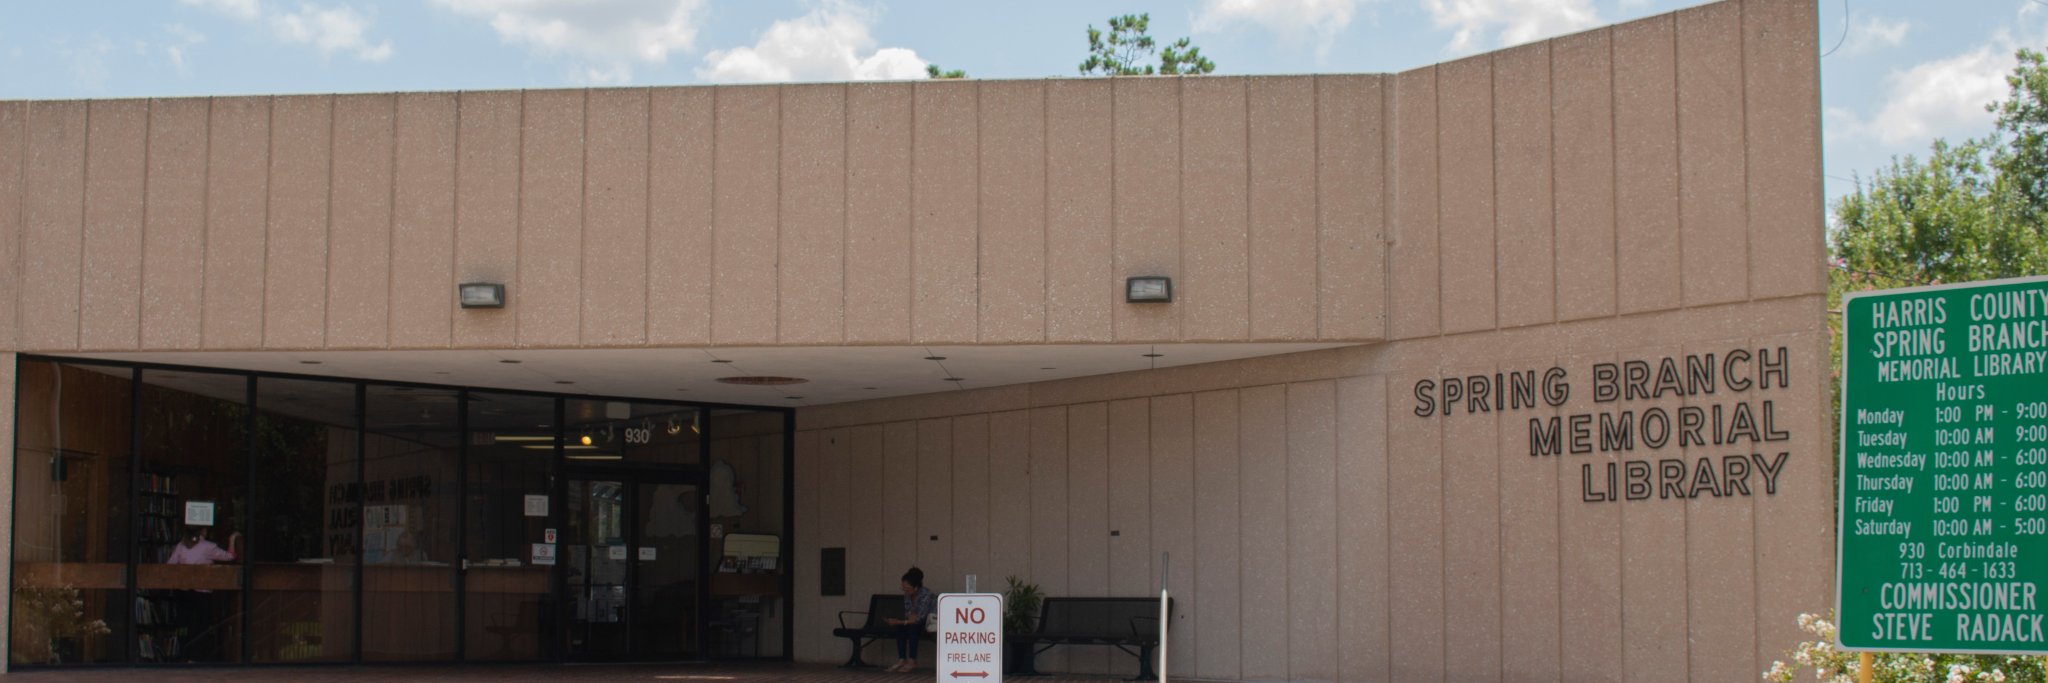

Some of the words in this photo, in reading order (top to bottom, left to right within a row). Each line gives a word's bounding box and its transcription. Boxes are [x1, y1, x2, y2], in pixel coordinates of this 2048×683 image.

[1873, 298, 1947, 329] HARRIS
[1970, 289, 2048, 321] COUNTY
[1873, 328, 1945, 358] SPRING
[1878, 357, 1961, 382] MEMORIAL
[1974, 350, 2047, 377] LIBRARY
[1414, 367, 1570, 418] SPRING
[1592, 347, 1789, 403] BRANCH
[1936, 383, 1984, 401] Hours
[1857, 408, 1904, 426] Monday
[1935, 406, 1961, 423] 1:00
[1975, 405, 1993, 421] PM
[2016, 402, 2047, 419] 9:00
[625, 428, 650, 444] 930
[1530, 400, 1789, 456] MEMORIAL
[1858, 430, 1906, 449] Tuesday
[1935, 428, 1970, 445] 10:00
[1974, 427, 1993, 444] AM
[2015, 425, 2047, 442] 9:00
[1857, 452, 1926, 470] Wednesday
[1935, 451, 1969, 468] 10:00
[1974, 450, 1993, 466] AM
[2015, 448, 2046, 465] 6:00
[1582, 452, 1789, 502] LIBRARY
[1857, 475, 1913, 493] Thursday
[1934, 474, 1969, 490] 10:00
[1973, 473, 1993, 489] AM
[2015, 471, 2046, 488] 6:00
[1855, 497, 1893, 516] Friday
[1933, 497, 1959, 513] 1:00
[1973, 496, 1991, 512] PM
[2014, 494, 2046, 511] 6:00
[1855, 519, 1911, 538] Saturday
[1933, 519, 1968, 536] 10:00
[1972, 519, 1992, 535] AM
[2014, 518, 2045, 534] 5:00
[1899, 543, 1924, 559] 930
[1938, 542, 2017, 558] Corbindale
[1901, 563, 1922, 579] 713
[1938, 562, 1966, 579] 464
[1983, 562, 2015, 578] 1633
[1880, 582, 2036, 610] COMMISSIONER
[955, 607, 985, 625] NO
[1871, 613, 1932, 640] STEVE
[1956, 614, 2044, 642] RADACK
[945, 631, 996, 645] PARKING
